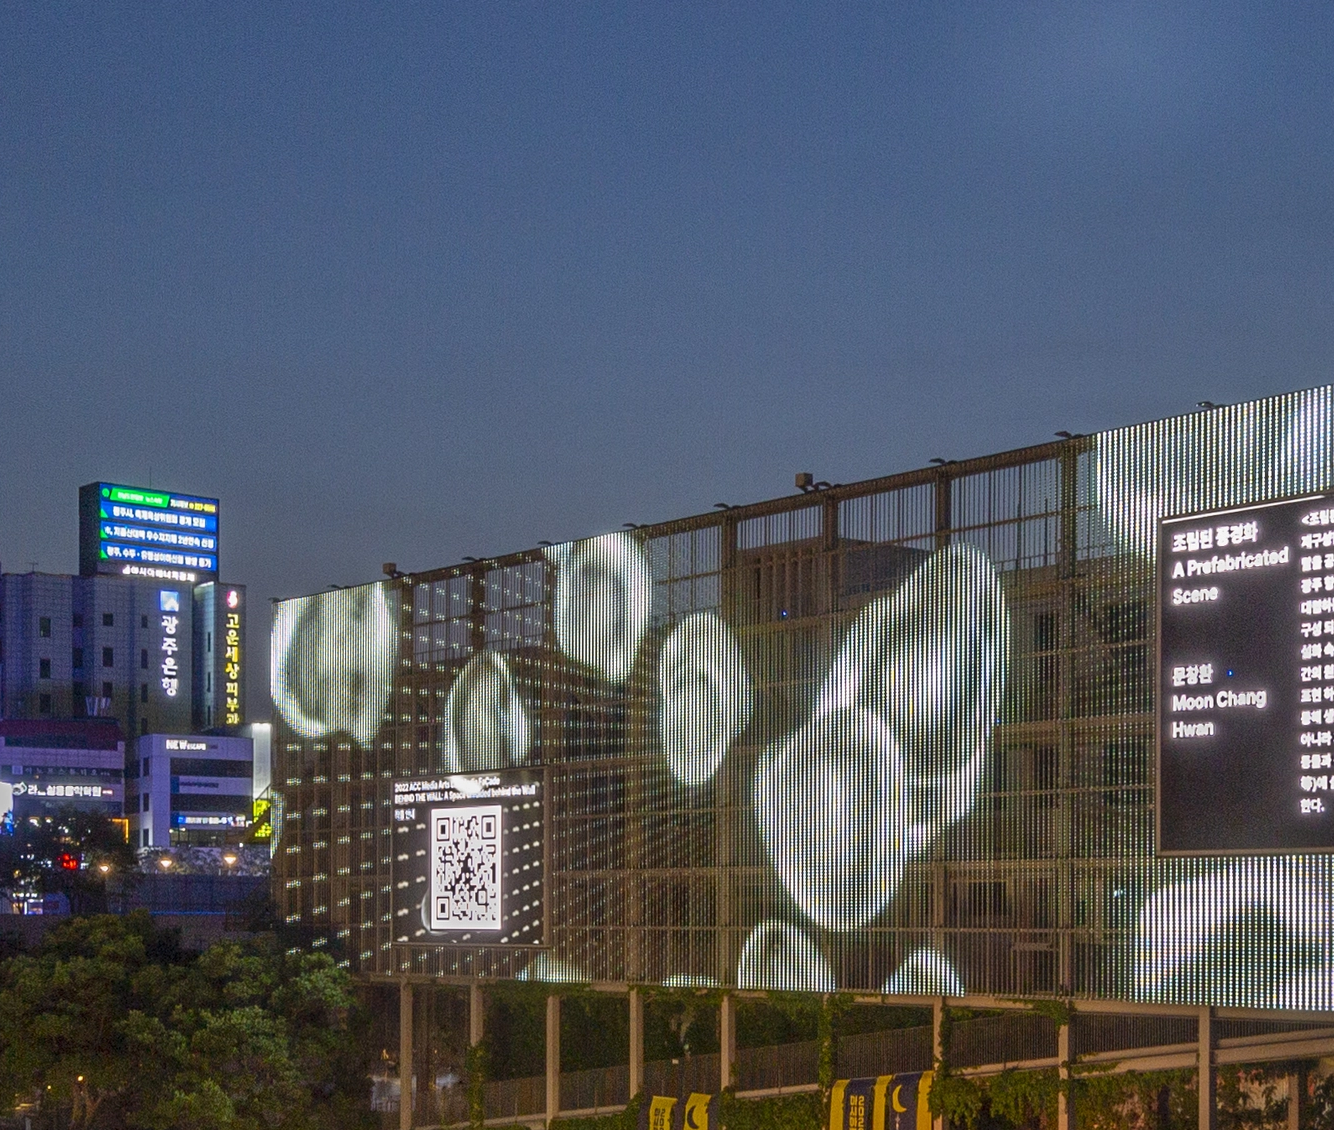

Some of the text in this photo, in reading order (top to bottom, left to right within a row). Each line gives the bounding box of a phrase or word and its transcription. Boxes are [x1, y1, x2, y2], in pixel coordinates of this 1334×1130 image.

[1172, 528, 1213, 551] 조립된
[1172, 546, 1289, 579] A Prefabricated
[1173, 586, 1218, 605] Scene
[161, 615, 178, 696] 광주은행
[225, 613, 239, 724] 고운세상피부과
[1173, 663, 1213, 686] 문창환
[1173, 690, 1266, 711] Moon Chang
[1172, 721, 1214, 738] Hwan
[166, 739, 187, 750] NEW
[395, 783, 408, 793] 2022
[409, 782, 421, 792] ACC
[416, 792, 426, 802] THE
